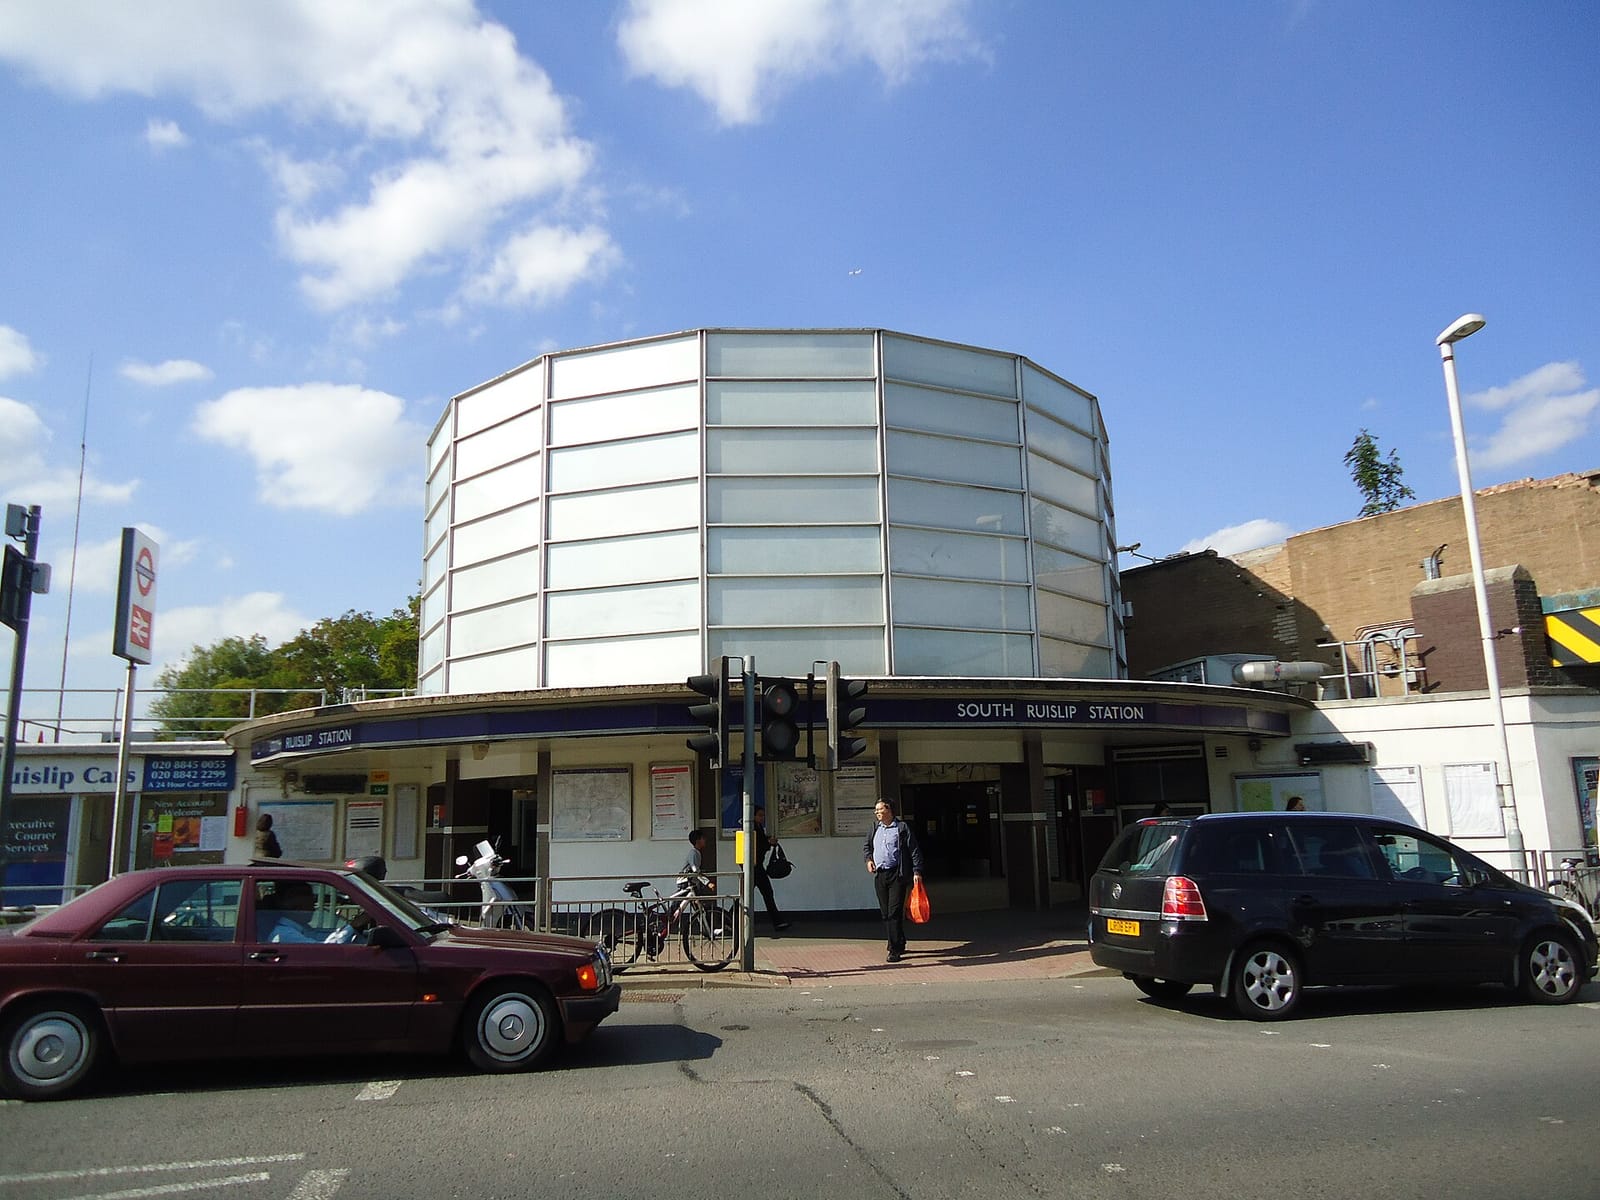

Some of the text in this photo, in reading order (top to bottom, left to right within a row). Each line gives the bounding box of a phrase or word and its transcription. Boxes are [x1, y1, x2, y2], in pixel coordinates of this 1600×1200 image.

[957, 703, 1145, 720] SOUTH RUISLIP STATION
[285, 734, 313, 749] RUISLIP
[318, 729, 352, 745] STATION
[151, 760, 171, 769] 020
[13, 766, 137, 790] uislip Cas
[151, 770, 171, 779] 020
[201, 780, 228, 788] Service
[8, 819, 55, 830] xecutive
